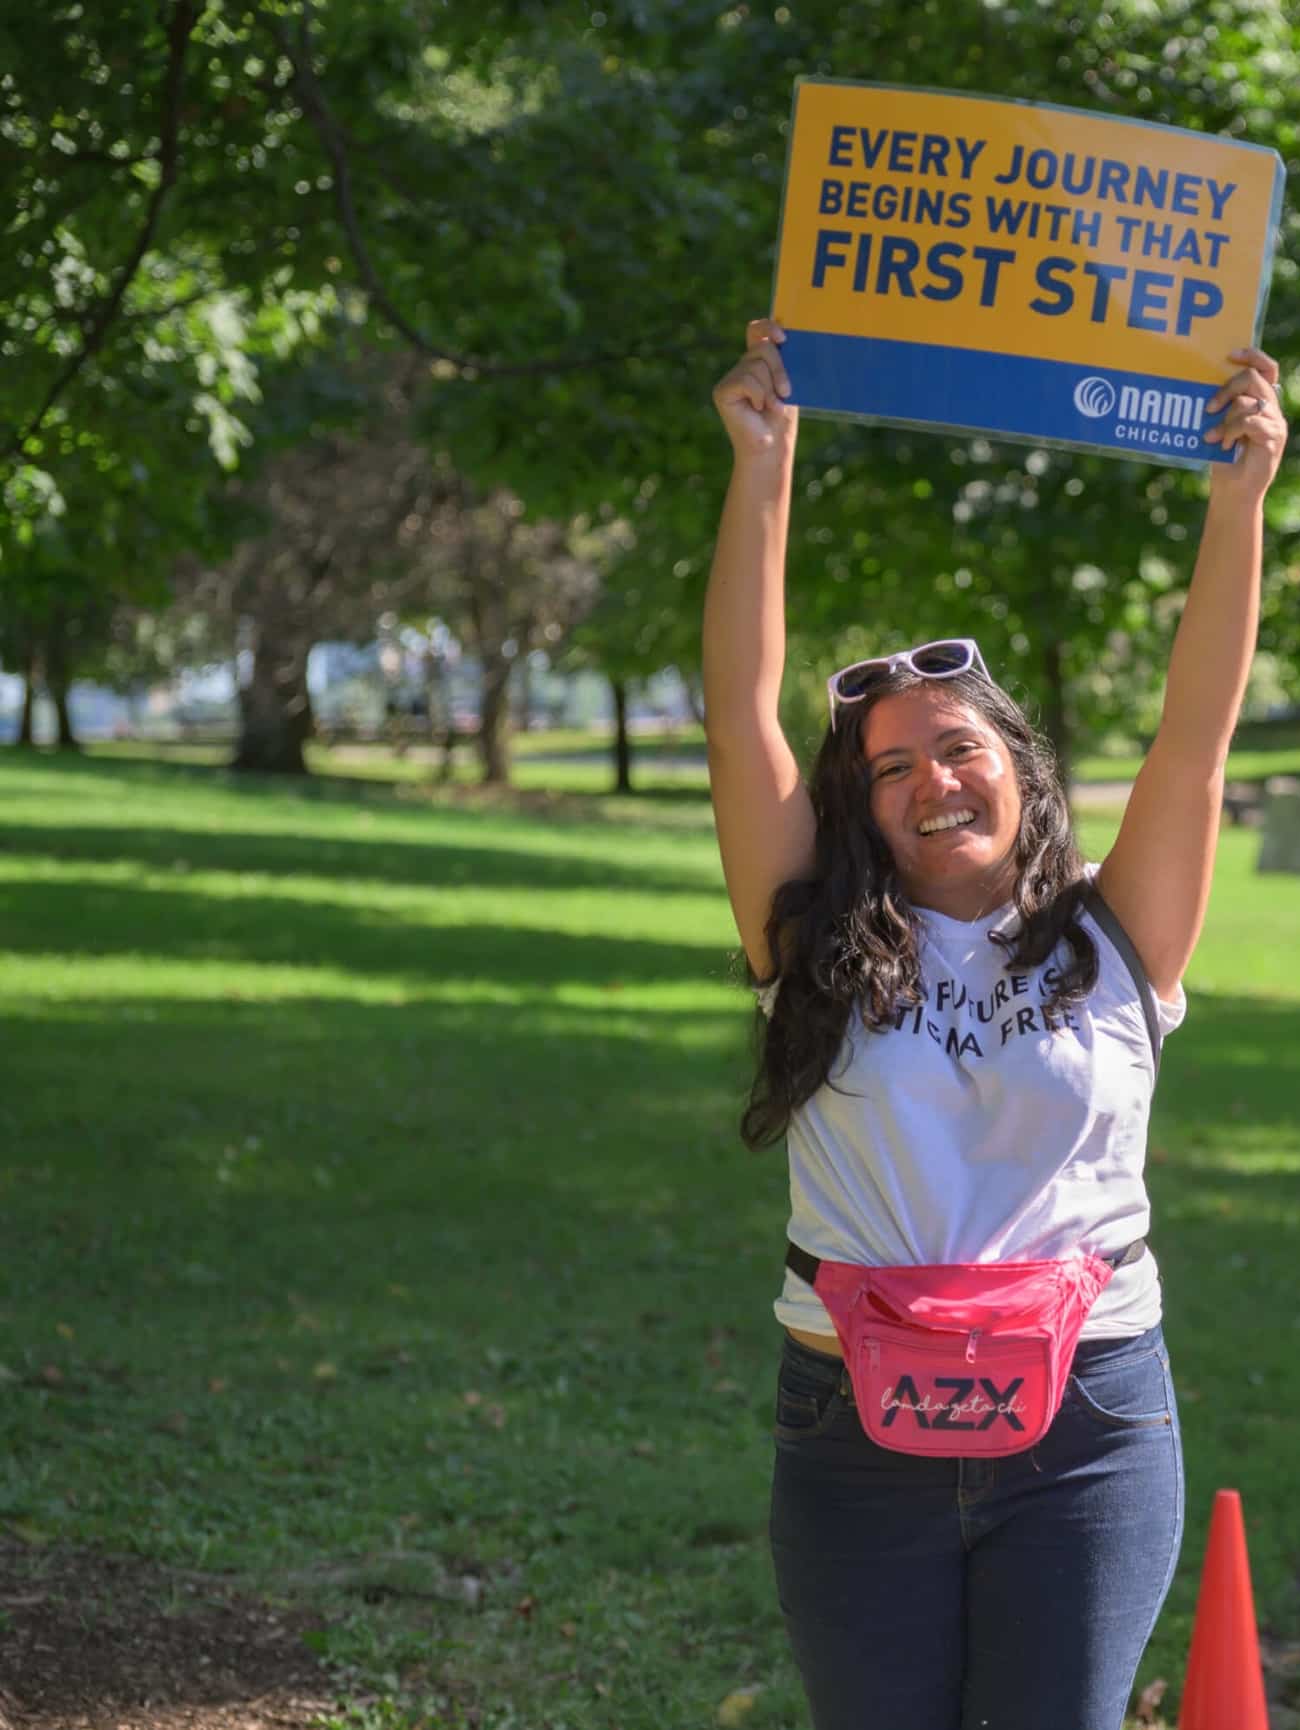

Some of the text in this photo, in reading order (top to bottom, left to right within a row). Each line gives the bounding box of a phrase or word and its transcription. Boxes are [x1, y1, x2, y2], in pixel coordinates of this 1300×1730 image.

[828, 125, 1238, 221] EVERY JOURNEY
[819, 179, 1230, 268] BEGINS WITH THAT
[811, 229, 1224, 336] FIRST STEP
[1115, 424, 1199, 449] CHICAGO
[1117, 385, 1205, 431] NAMI
[936, 975, 1029, 1024] FUTURE
